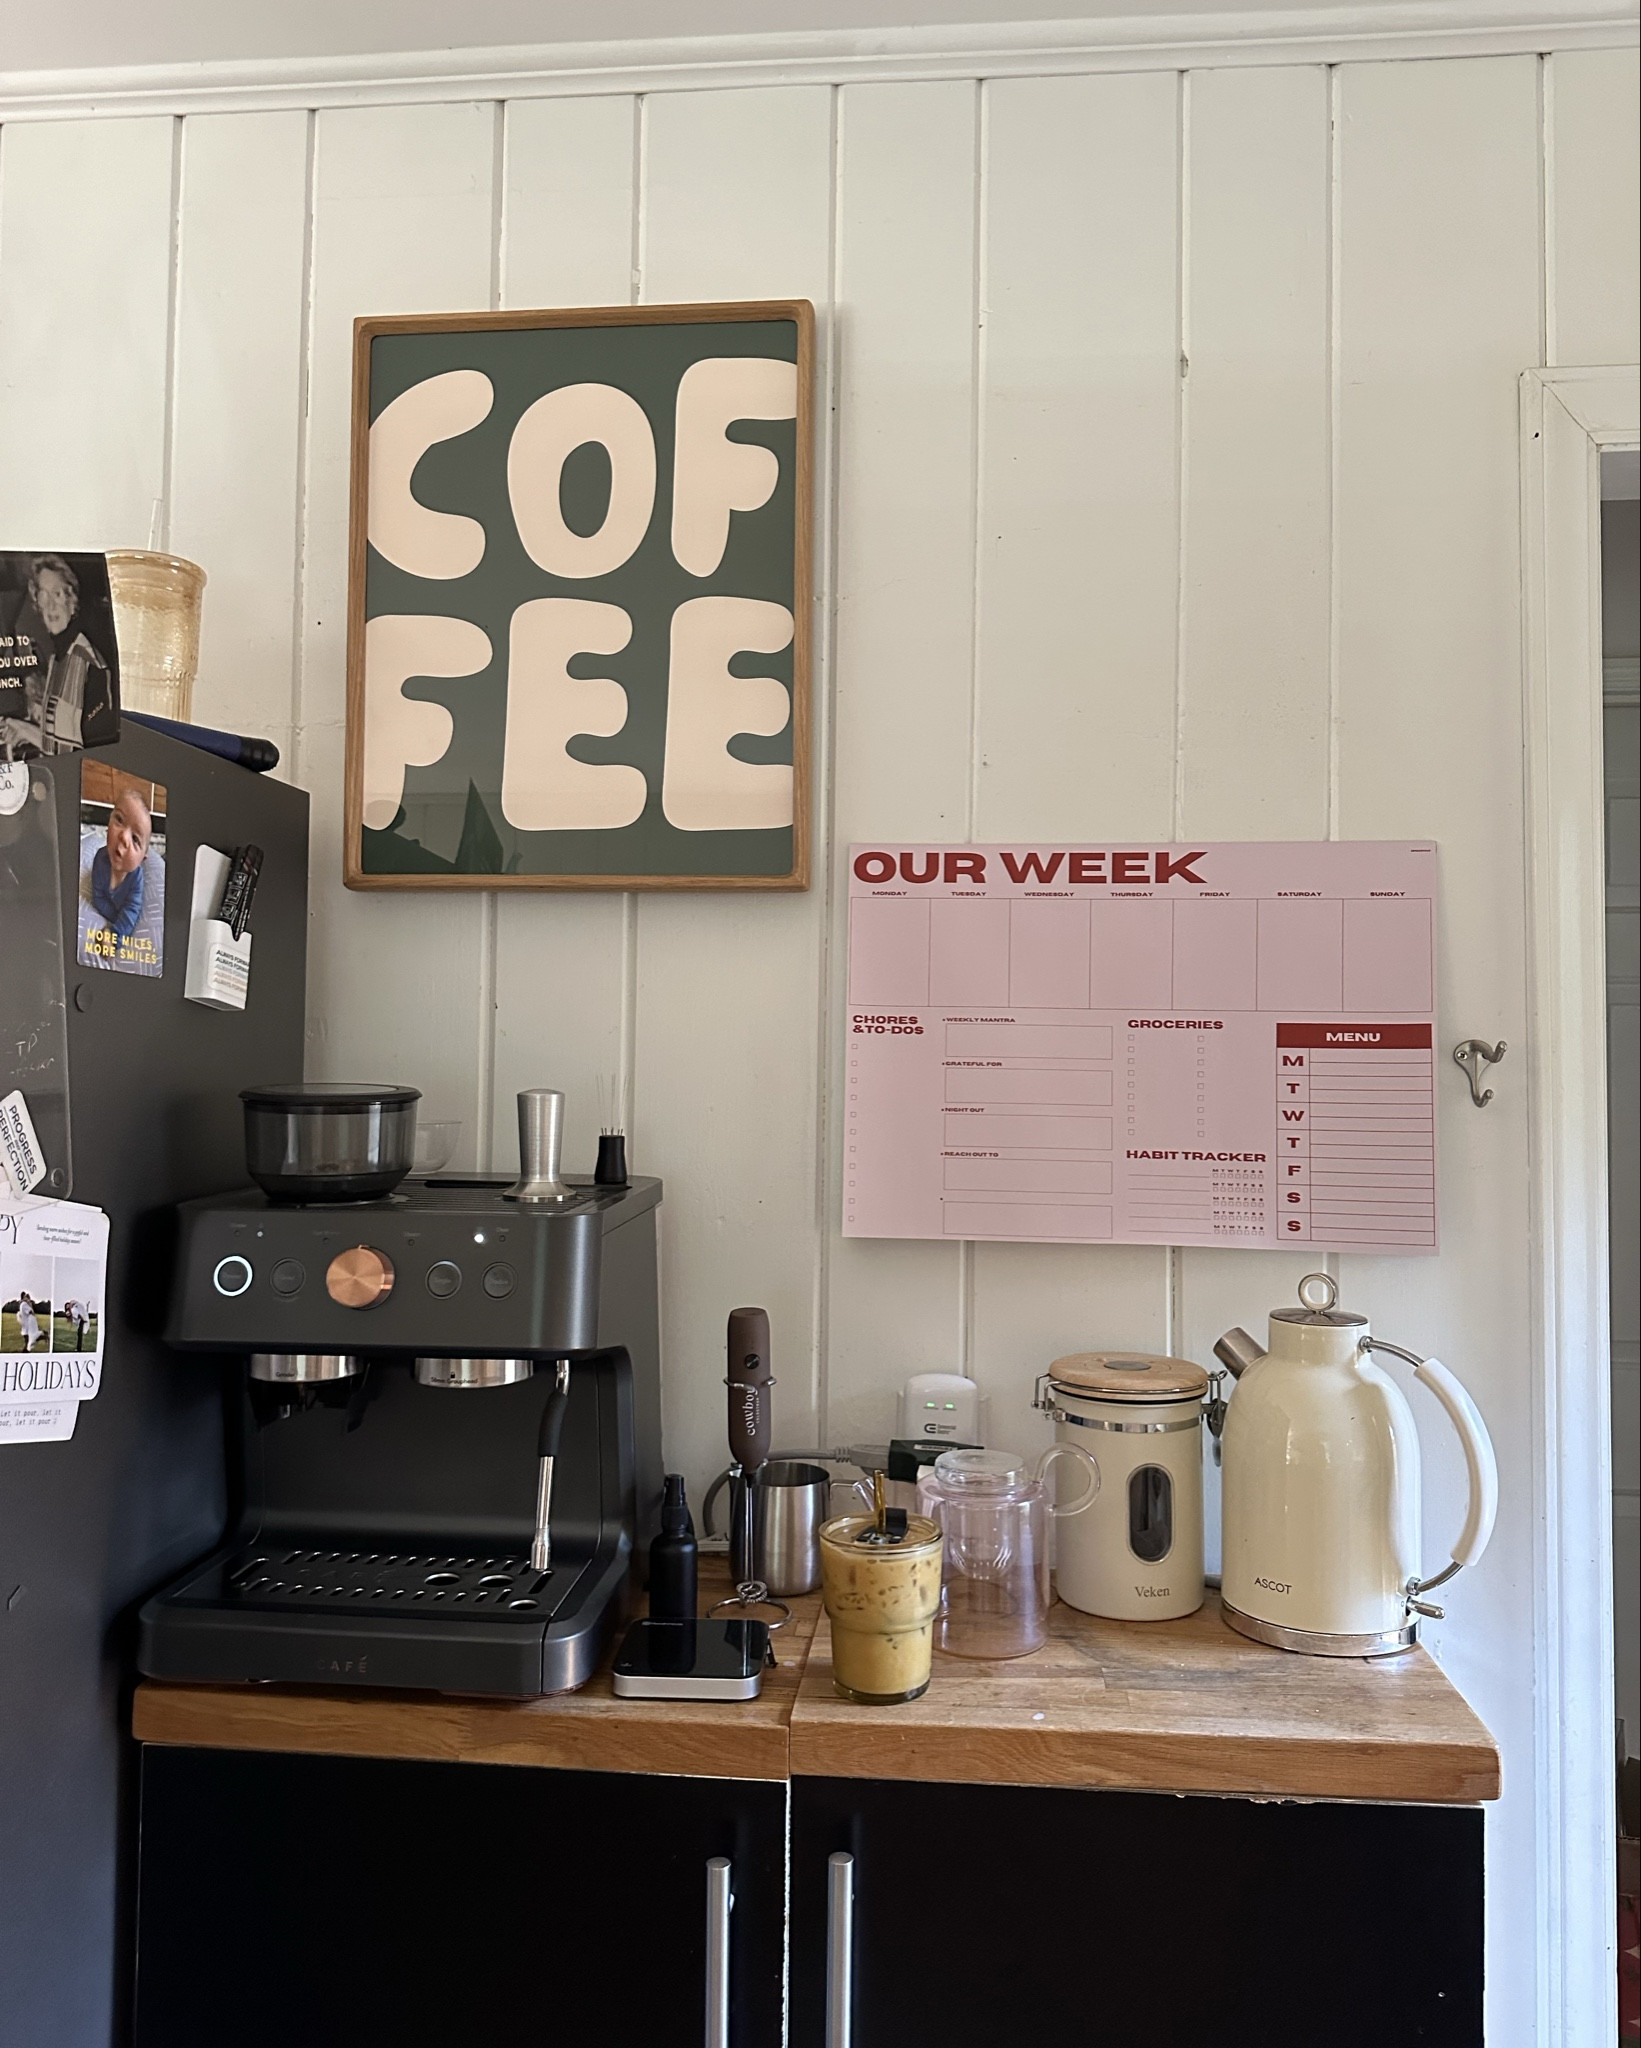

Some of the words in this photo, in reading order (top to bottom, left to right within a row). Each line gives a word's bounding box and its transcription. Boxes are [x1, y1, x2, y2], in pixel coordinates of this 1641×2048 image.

[367, 357, 797, 580] COF
[17, 635, 30, 646] TO
[14, 655, 38, 667] OVER
[362, 596, 795, 831] FEE
[853, 851, 987, 884] OUR
[998, 851, 1209, 884] WEEK
[87, 928, 118, 944] MORE
[122, 935, 156, 953] MILES,
[85, 941, 116, 958] MORE
[120, 947, 157, 965] SMILES
[852, 1014, 918, 1025] CHORES
[1127, 1019, 1224, 1030] GROCERIES
[1326, 1032, 1381, 1042] MENU
[1282, 1055, 1304, 1067] M
[1286, 1082, 1300, 1094] T
[1281, 1110, 1305, 1122] W
[9, 1105, 37, 1175] PROGRESS
[1286, 1137, 1301, 1149] T
[1126, 1149, 1179, 1160] HABIT
[1181, 1151, 1266, 1163] TRACKER
[1287, 1165, 1302, 1177] F
[1286, 1191, 1301, 1204] S
[1287, 1220, 1301, 1232] S
[2, 1360, 96, 1391] HOLIDAYS
[742, 1386, 758, 1436] cowboy
[1134, 1586, 1171, 1598] Veken
[1254, 1577, 1293, 1595] ASCOT
